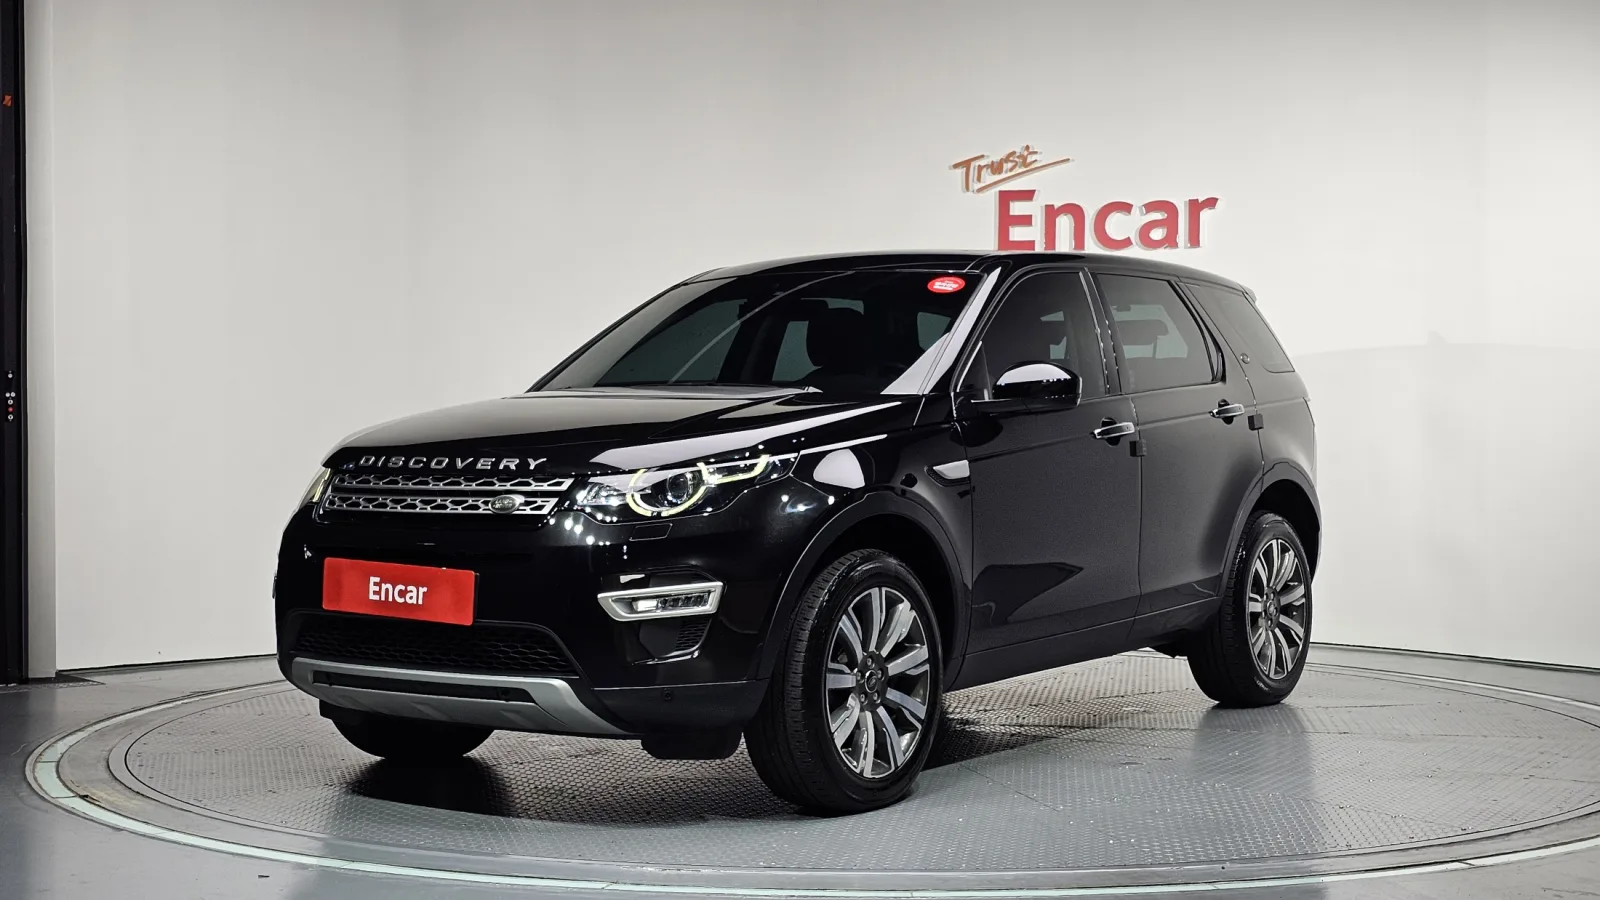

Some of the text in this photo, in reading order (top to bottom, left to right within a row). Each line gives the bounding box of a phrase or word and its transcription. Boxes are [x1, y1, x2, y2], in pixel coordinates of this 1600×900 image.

[952, 144, 1039, 192] Trust
[997, 189, 1219, 251] Encar
[358, 455, 547, 472] DISCOVERY
[368, 576, 428, 605] Encar
